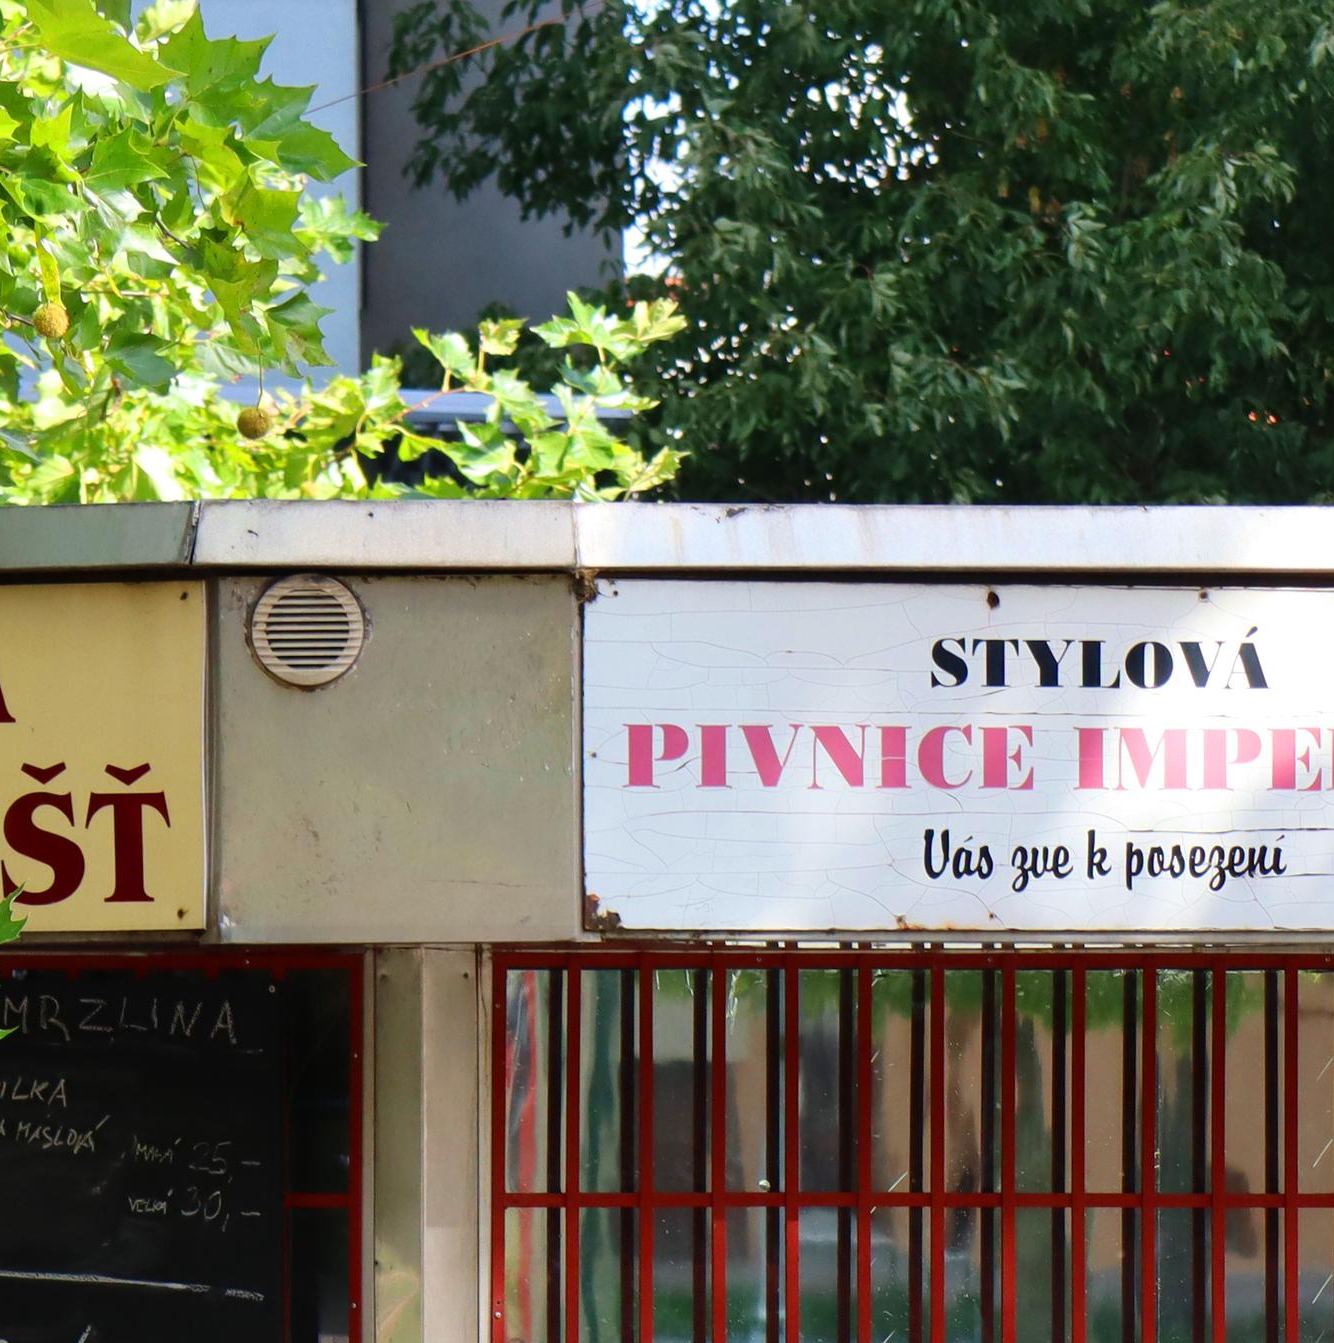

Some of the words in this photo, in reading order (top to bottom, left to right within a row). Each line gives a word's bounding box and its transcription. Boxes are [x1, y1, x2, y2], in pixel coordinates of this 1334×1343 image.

[929, 626, 1271, 690] STYLOVÁ
[624, 723, 1035, 790] PIVNICE
[922, 828, 995, 880] Vás
[1010, 845, 1073, 893] zve
[1086, 829, 1110, 880] k
[1125, 832, 1288, 893] posezení
